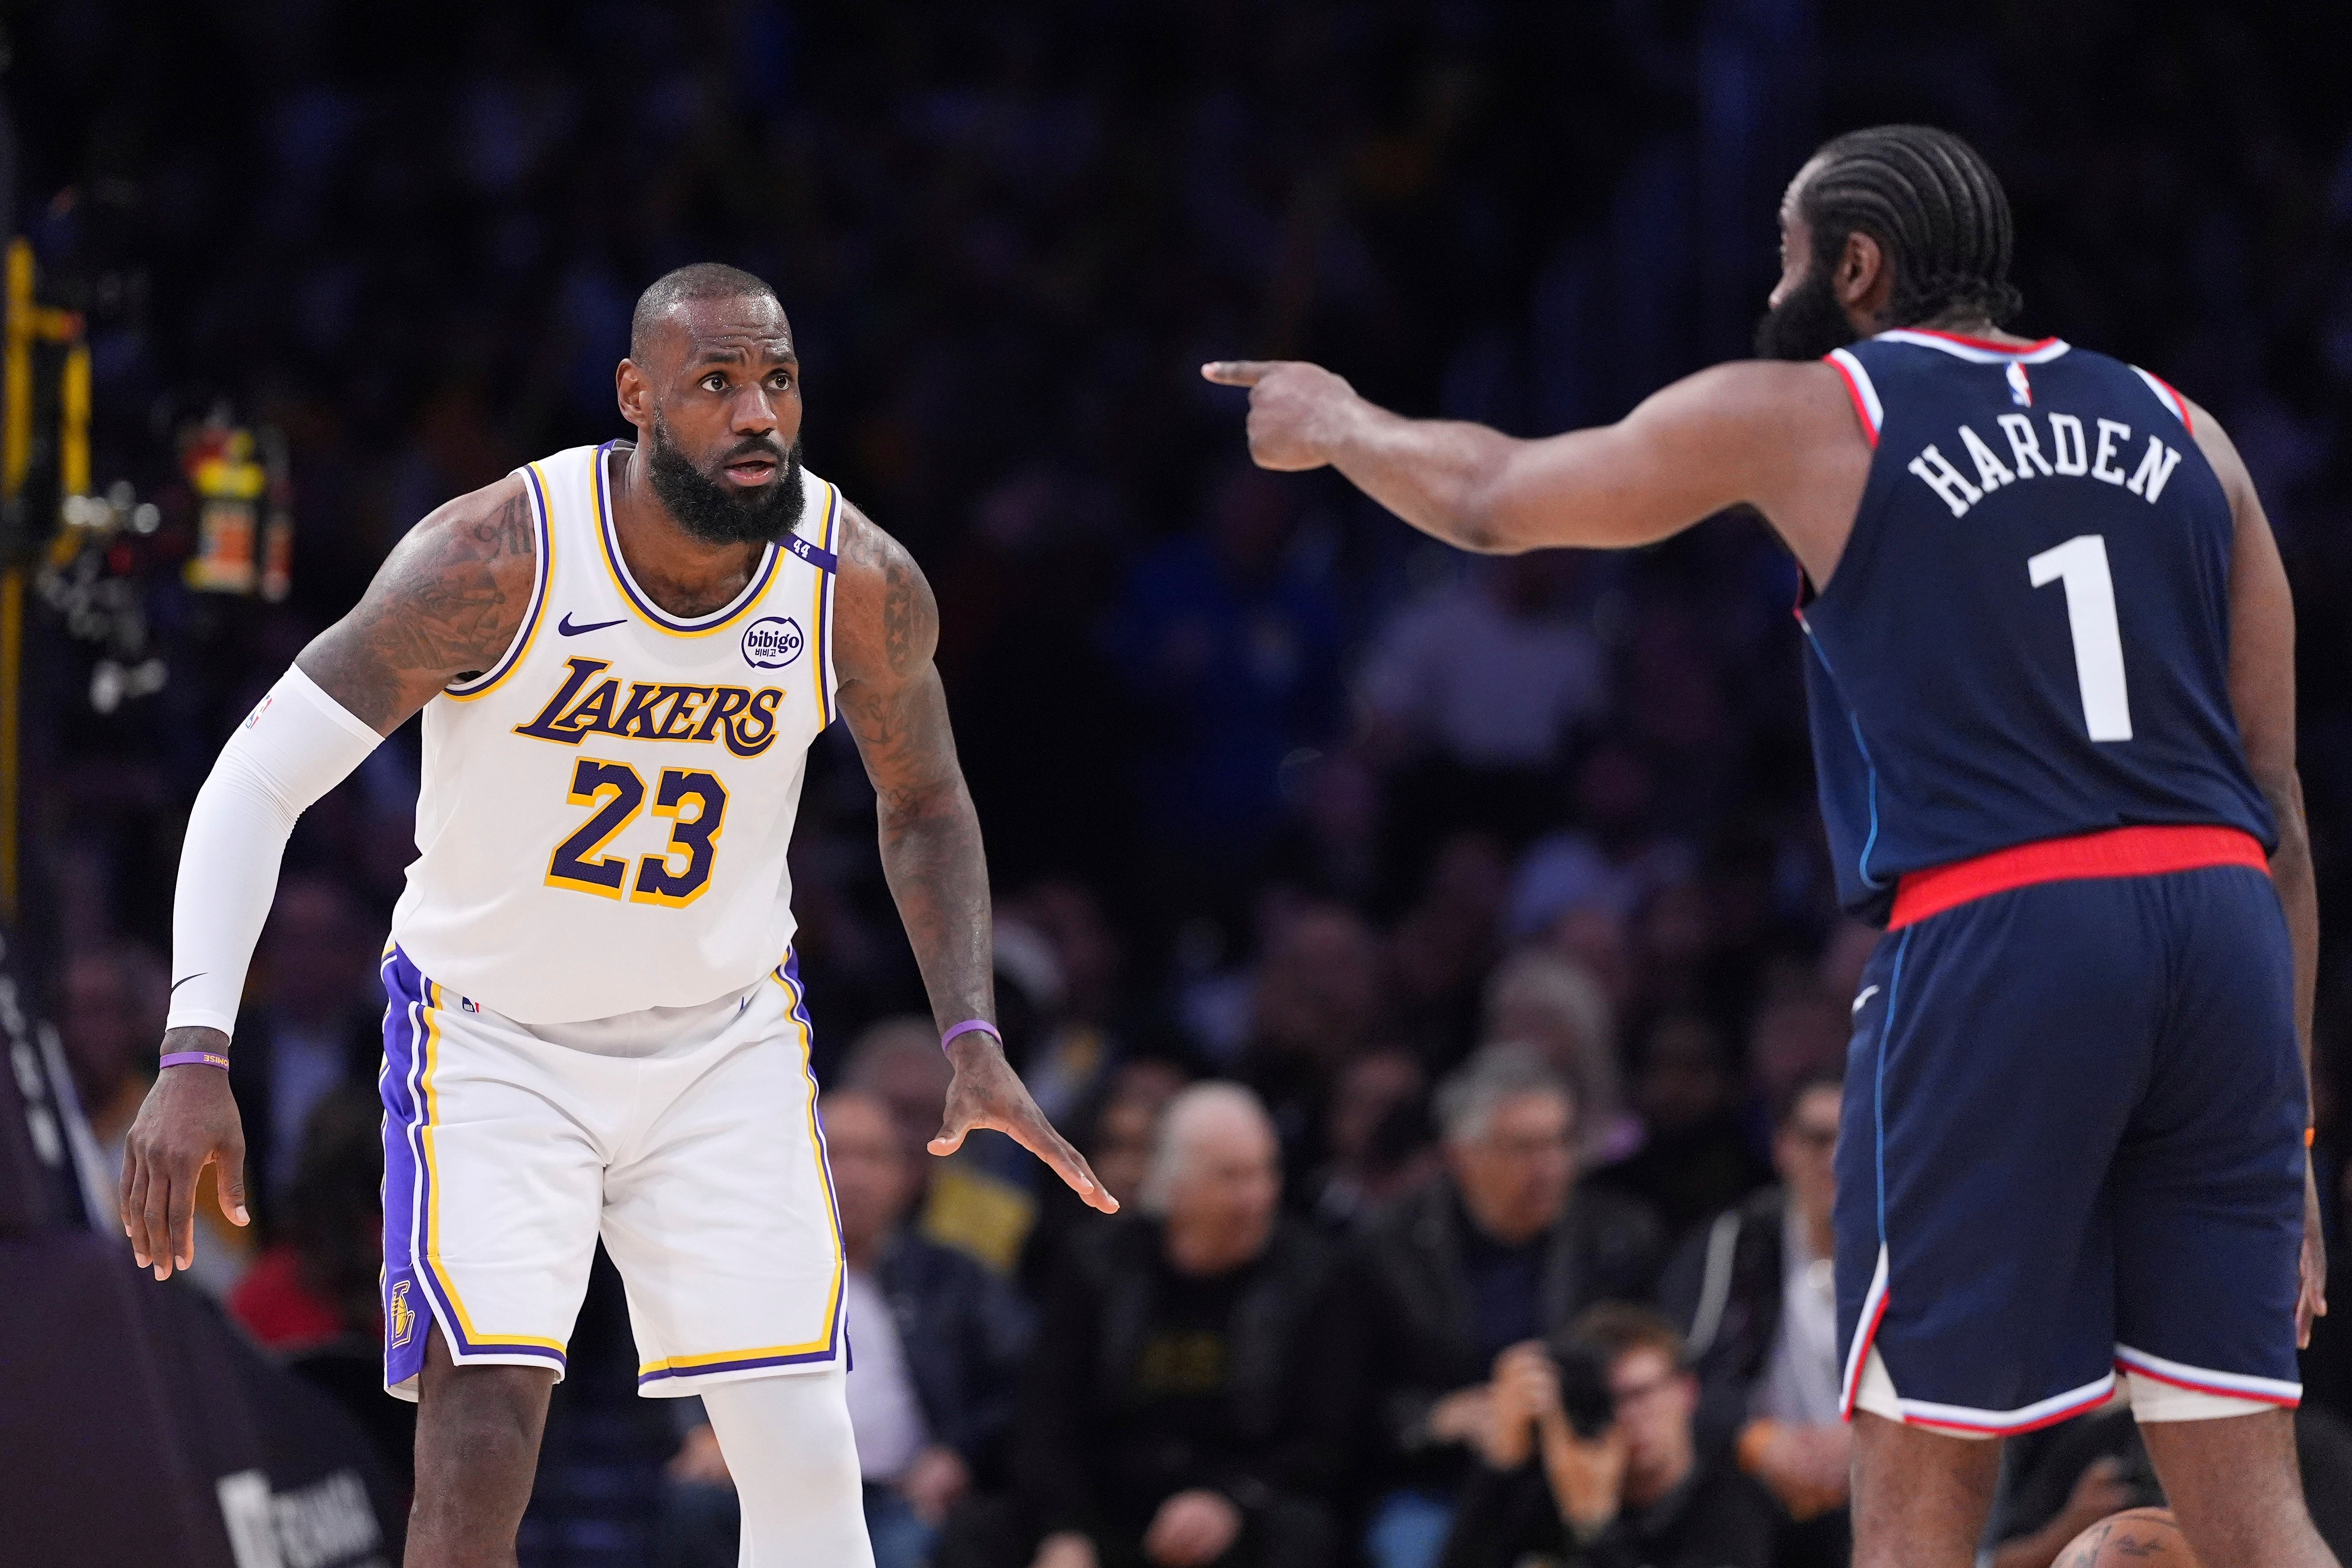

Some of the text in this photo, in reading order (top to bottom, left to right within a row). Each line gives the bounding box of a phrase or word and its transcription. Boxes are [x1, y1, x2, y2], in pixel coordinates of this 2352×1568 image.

[1907, 412, 2182, 518] HARDEN
[793, 539, 811, 558] 44
[747, 630, 799, 654] bibigo
[2027, 534, 2133, 742] 1
[755, 648, 776, 657] 비비고
[509, 654, 787, 759] LAKERS
[543, 756, 730, 909] 23
[464, 1003, 473, 1011] NBA
[204, 1054, 229, 1067] OMISE
